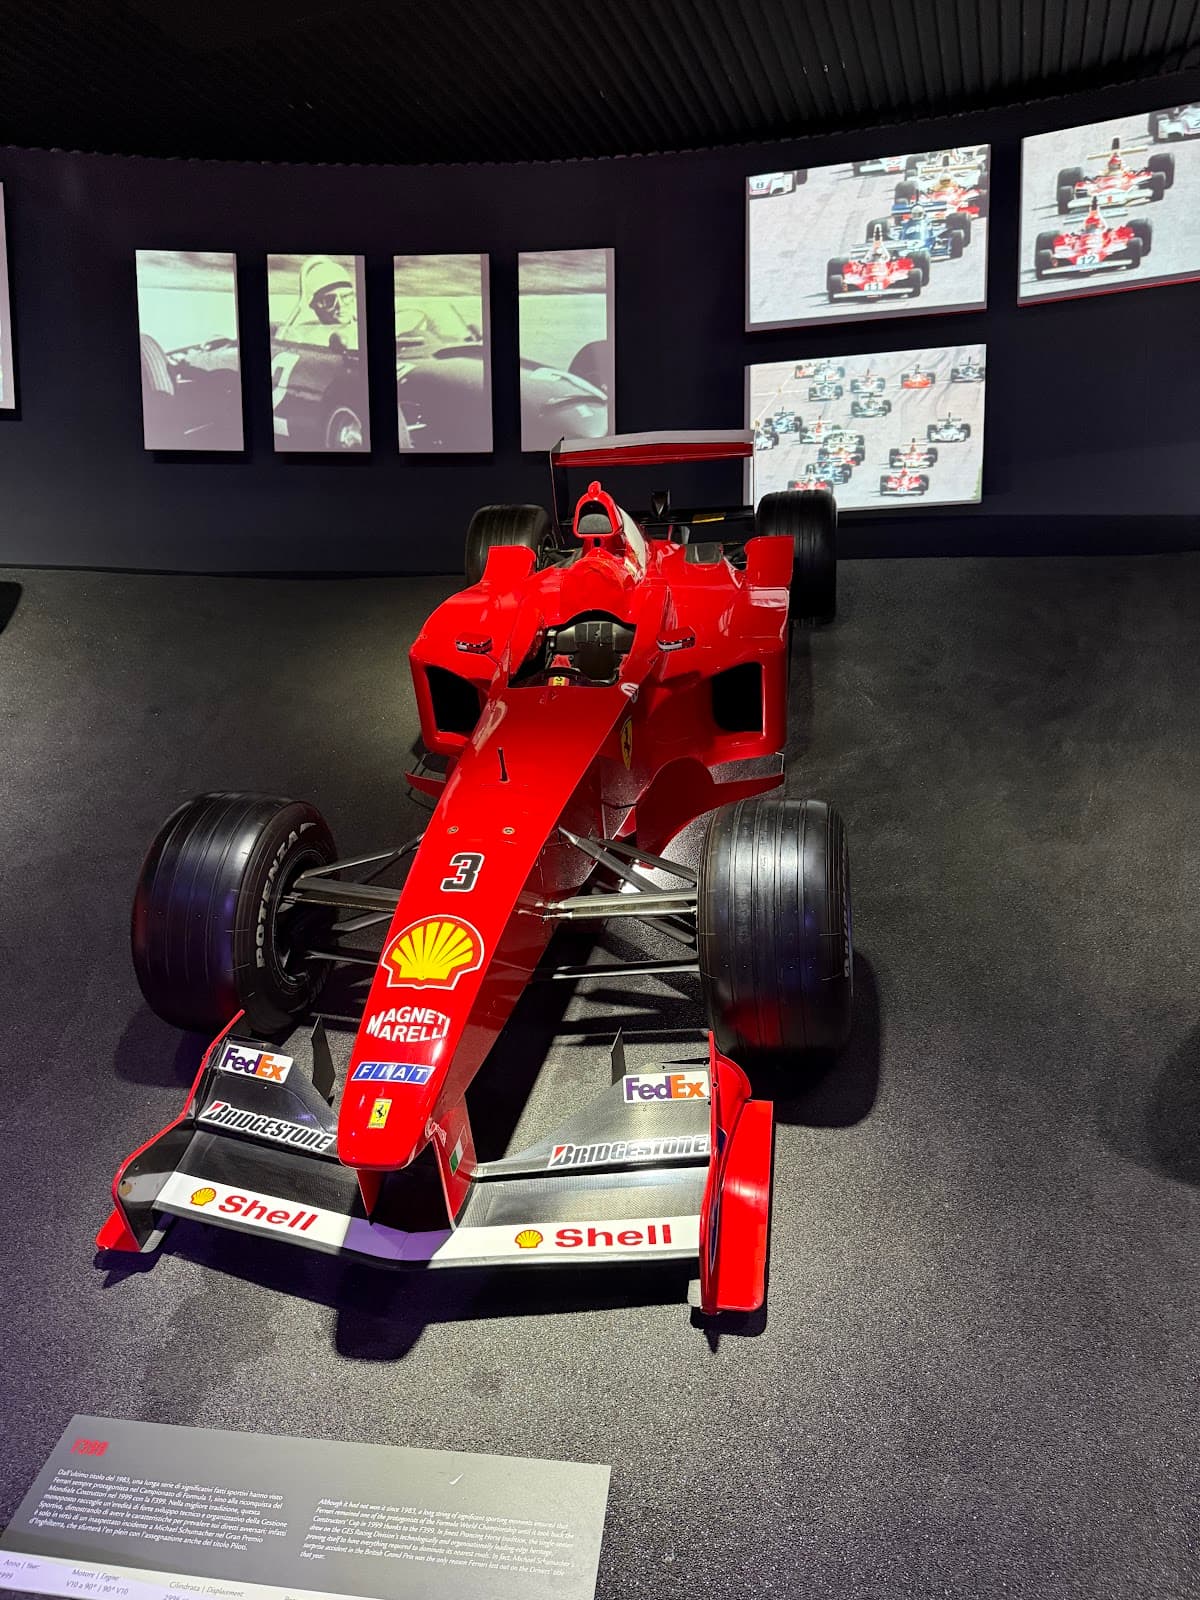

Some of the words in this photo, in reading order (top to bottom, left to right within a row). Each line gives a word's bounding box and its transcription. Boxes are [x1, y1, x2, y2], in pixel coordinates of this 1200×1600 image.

[440, 852, 485, 893] 3
[221, 1047, 286, 1081] FedEx
[358, 1065, 428, 1078] FIAT
[625, 1074, 705, 1101] FedEx
[200, 1101, 334, 1151] BRIDGESTONE
[549, 1136, 709, 1166] BRIDGESTONE
[218, 1195, 319, 1231] Shell
[554, 1224, 672, 1248] Shell
